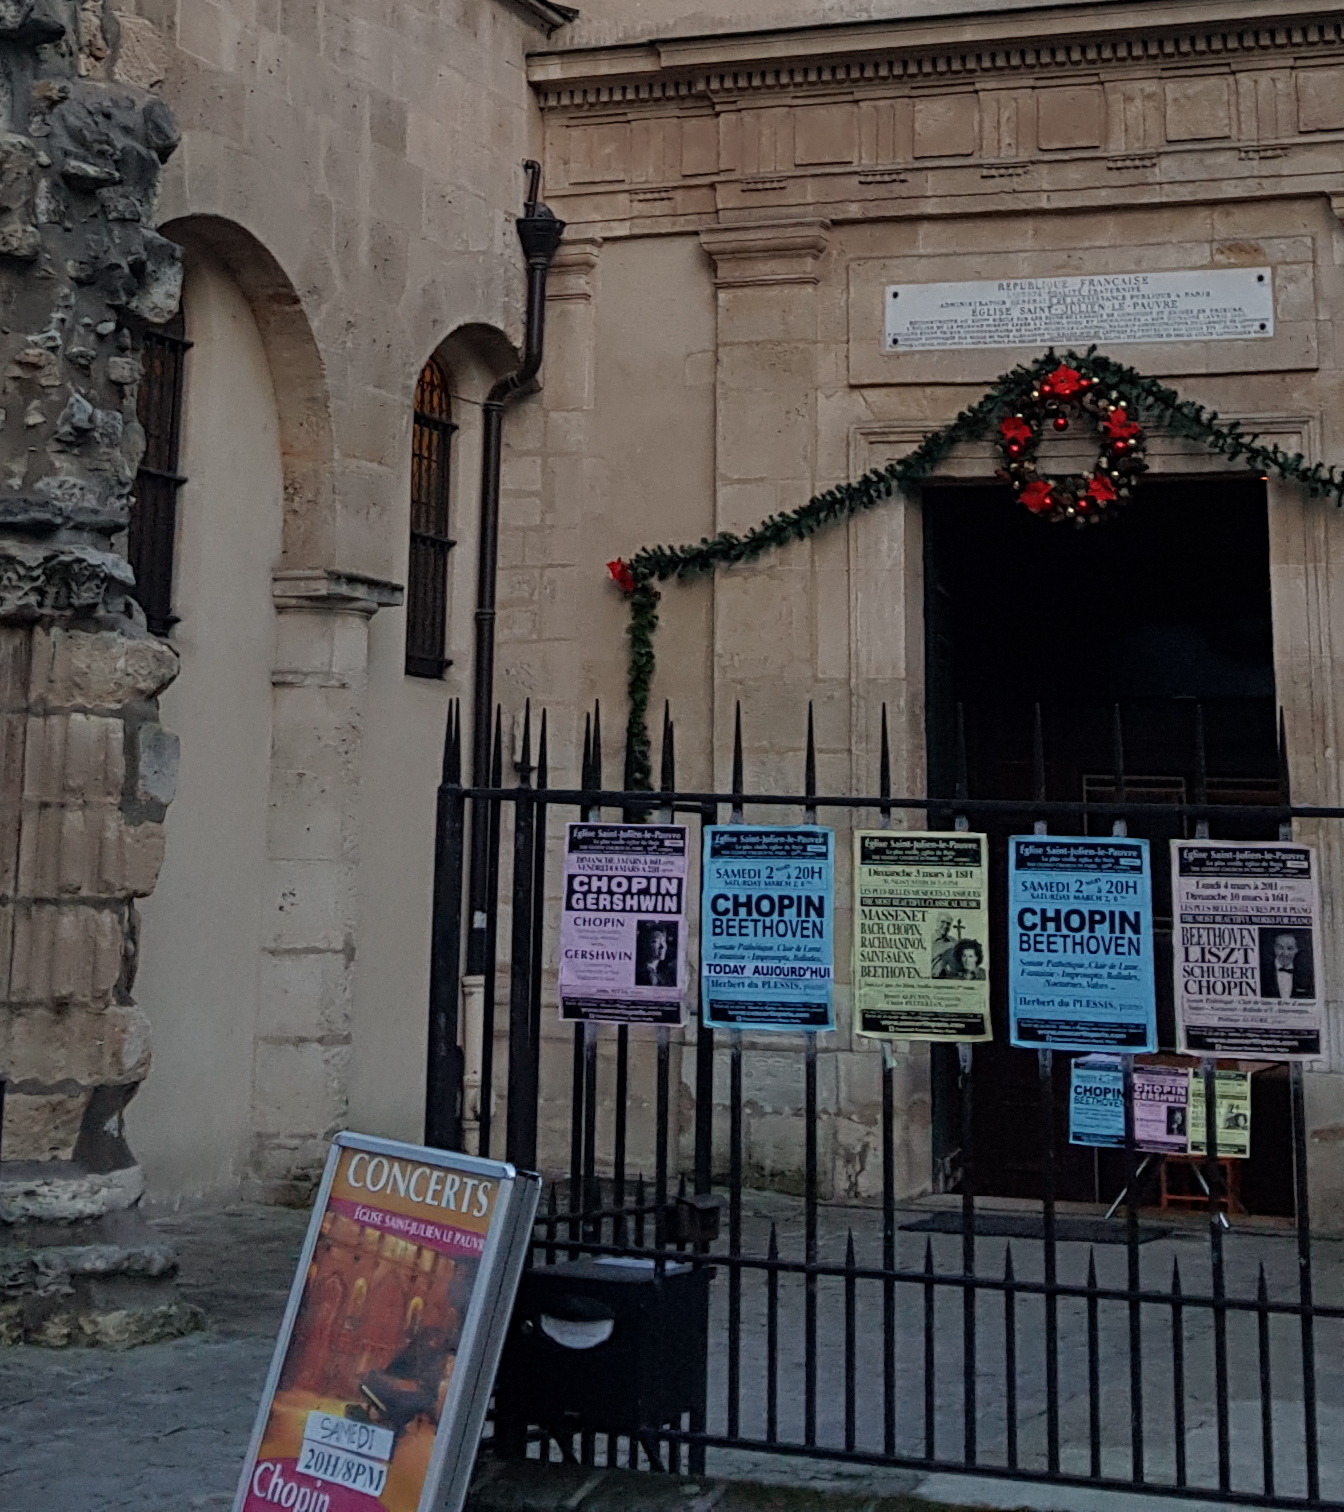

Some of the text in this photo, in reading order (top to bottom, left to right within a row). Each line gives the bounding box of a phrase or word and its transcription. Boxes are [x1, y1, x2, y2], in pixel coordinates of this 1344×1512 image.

[1019, 844, 1138, 858] Église Saint-Julien-le-Pauvre
[1210, 850, 1305, 860] Saint-Julien-le-Pauvre
[716, 868, 761, 879] SAMEDI
[765, 866, 774, 879] 2
[795, 866, 823, 879] 20H
[868, 868, 913, 877] Dimanche
[915, 869, 921, 877] 3
[573, 875, 678, 894] CHOPIN
[1021, 881, 1070, 893] SAMEDI
[1075, 879, 1084, 893] 2
[1106, 880, 1137, 894] 20H
[1196, 880, 1221, 889] Lundi
[1224, 881, 1228, 889] 4
[571, 893, 678, 912] GERSHWIN
[1186, 892, 1228, 901] Dimanche
[1230, 892, 1239, 901] 10
[1264, 893, 1269, 902] à
[1272, 893, 1288, 902] 16H
[710, 893, 825, 918] CHOPIN
[574, 916, 625, 927] CHOPIN
[861, 909, 928, 922] MASSENET
[1018, 907, 1142, 935] CHOPIN
[711, 917, 824, 939] BEETHOVEN
[861, 923, 922, 936] BACH, CHOPIN,
[1182, 927, 1256, 947] BEETHOVEN
[1019, 933, 1141, 956] BEETHOVEN
[565, 949, 632, 961] GERSHWIN
[1184, 947, 1255, 964] LISZT
[706, 964, 830, 978] TODAY AUJOURD'HUI
[1183, 965, 1257, 979] SCHUBERT
[711, 980, 745, 988] Herbert
[747, 980, 758, 989] du
[1184, 979, 1257, 996] CHOPIN
[1019, 997, 1055, 1007] Herbert
[1058, 999, 1069, 1007] du
[1073, 999, 1116, 1008] PLESSIS,
[1074, 1085, 1123, 1099] CHOPIN
[1134, 1083, 1187, 1095] CHOPIN
[1134, 1092, 1186, 1102] GERSHWIN
[348, 1152, 492, 1217] CONCERTS
[354, 1205, 385, 1225] ÉGLISE
[384, 1215, 442, 1240] SAINT-JULIEN
[443, 1229, 455, 1244] LE
[320, 1417, 376, 1450] SAMEDI
[303, 1448, 384, 1491] 20H/8PM
[253, 1462, 330, 1512] Chopin
